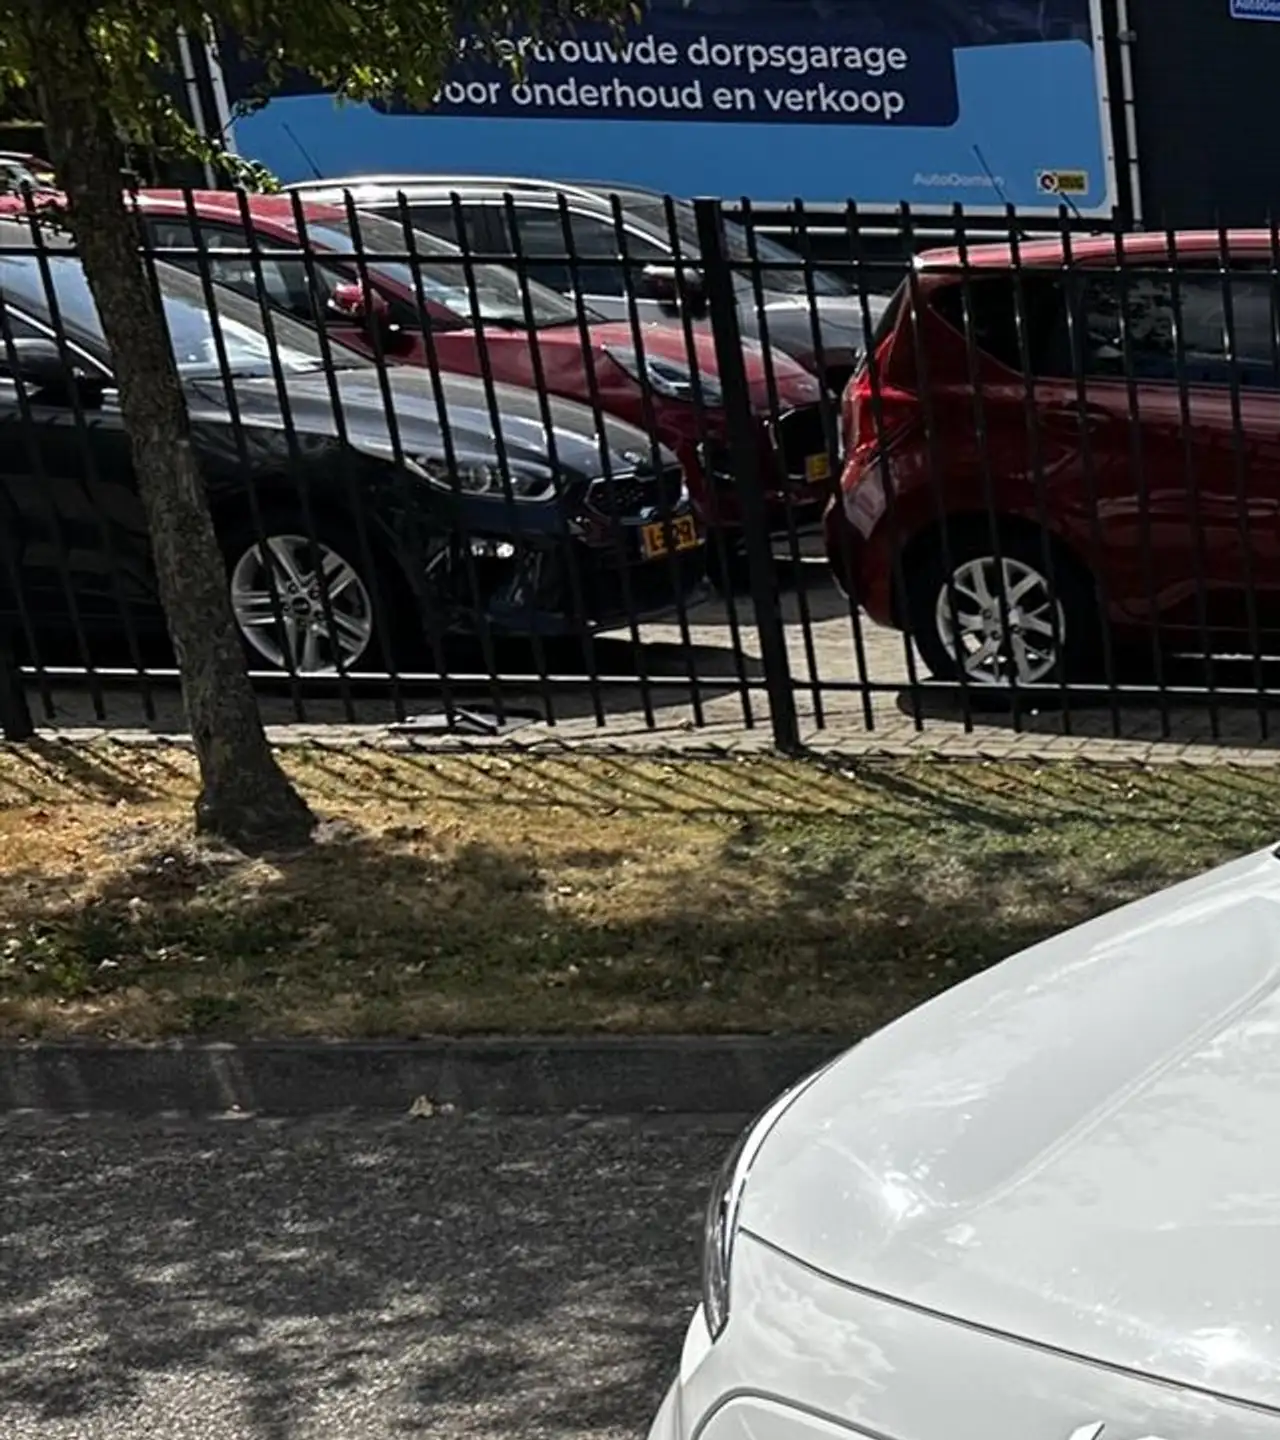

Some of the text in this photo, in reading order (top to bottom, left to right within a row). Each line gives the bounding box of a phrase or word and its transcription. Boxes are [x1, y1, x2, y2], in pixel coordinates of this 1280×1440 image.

[474, 34, 678, 66] ertrouwde
[687, 35, 908, 76] dorpsgarage
[511, 77, 704, 109] onderhoud
[712, 87, 756, 111] en
[764, 83, 906, 119] verkoop
